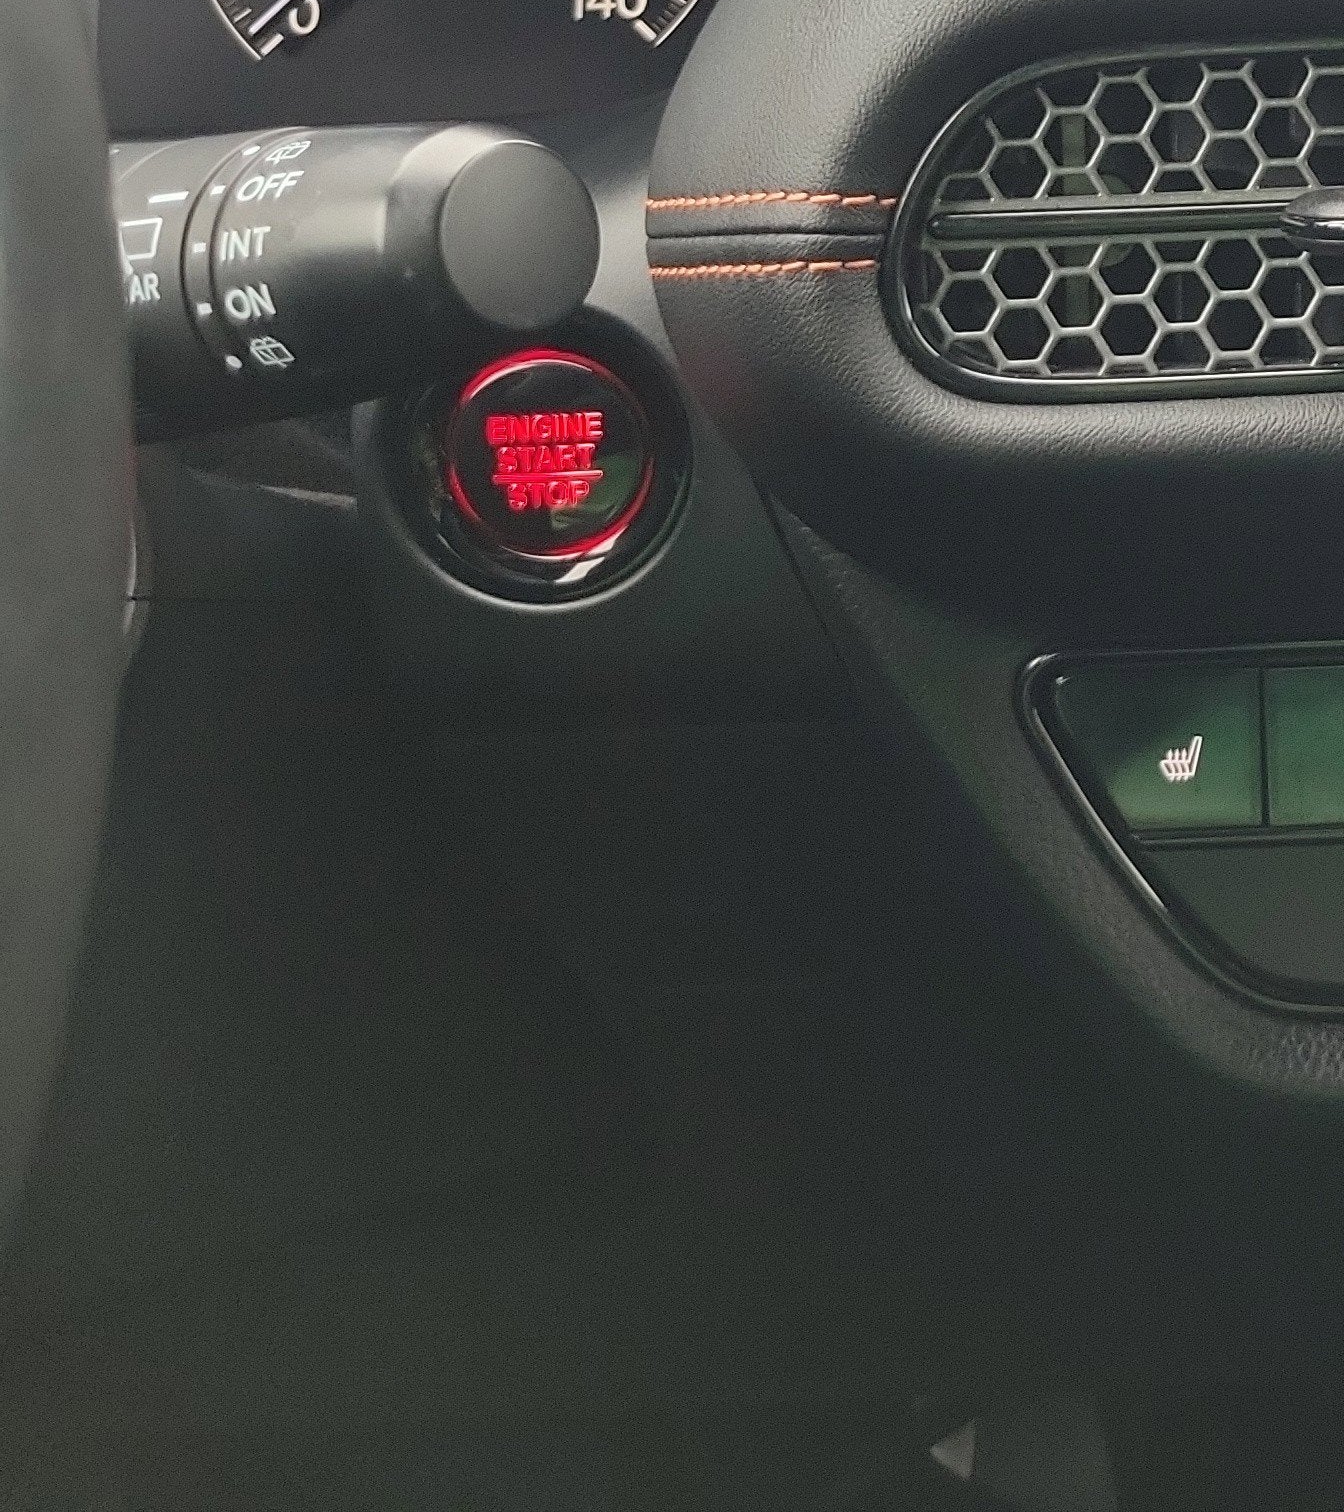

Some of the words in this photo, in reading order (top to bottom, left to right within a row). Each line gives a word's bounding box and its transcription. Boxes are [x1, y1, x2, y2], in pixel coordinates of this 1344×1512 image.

[235, 170, 305, 203] OFF
[219, 225, 272, 262] INT
[124, 273, 161, 305] AR
[224, 283, 276, 320] ON
[488, 412, 603, 444] ENGINE
[498, 444, 595, 472] START
[506, 481, 590, 510] STOP
